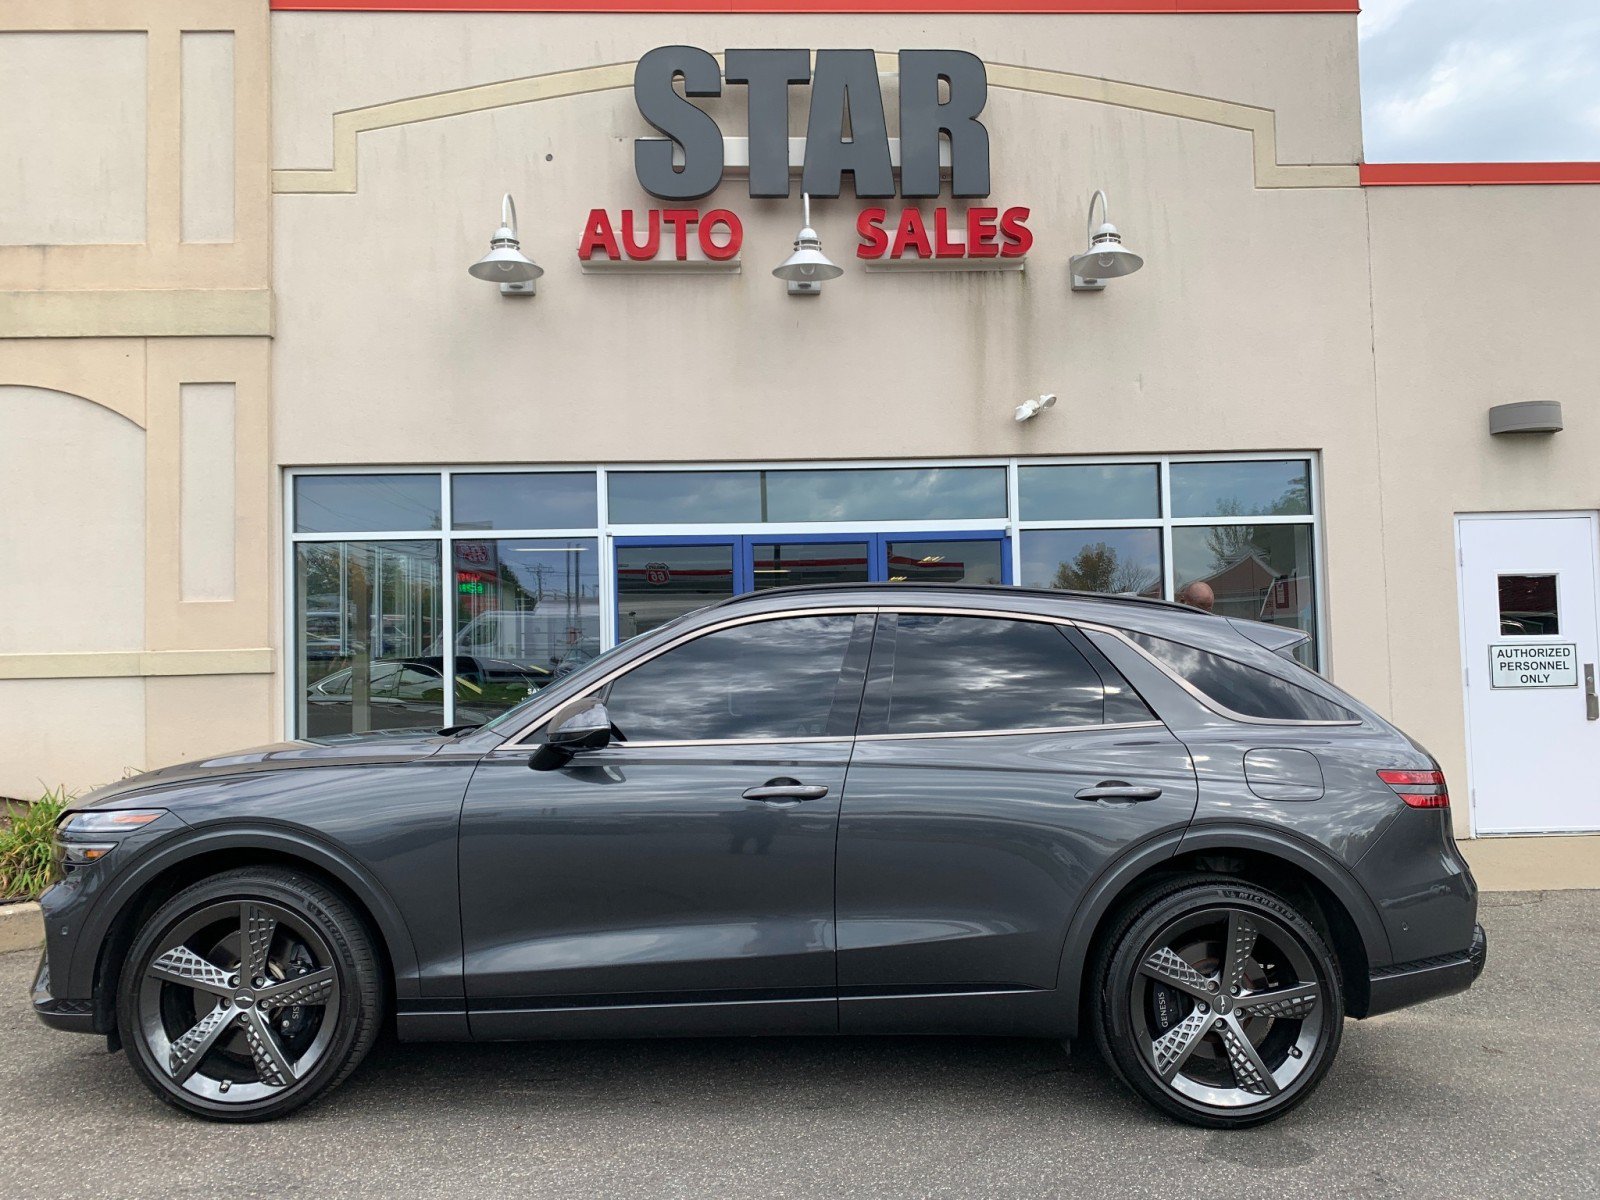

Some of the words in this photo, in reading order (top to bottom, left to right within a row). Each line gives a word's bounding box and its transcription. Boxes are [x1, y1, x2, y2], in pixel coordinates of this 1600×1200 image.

[634, 45, 990, 200] STAR
[578, 208, 743, 261] AUTO
[856, 206, 1033, 259] SALES
[1497, 648, 1571, 659] AUTHORIZED
[1499, 660, 1570, 671] PERSONNEL
[1520, 674, 1550, 684] ONLY
[1238, 892, 1293, 920] MICHELIN
[1157, 991, 1169, 1028] GENESIS
